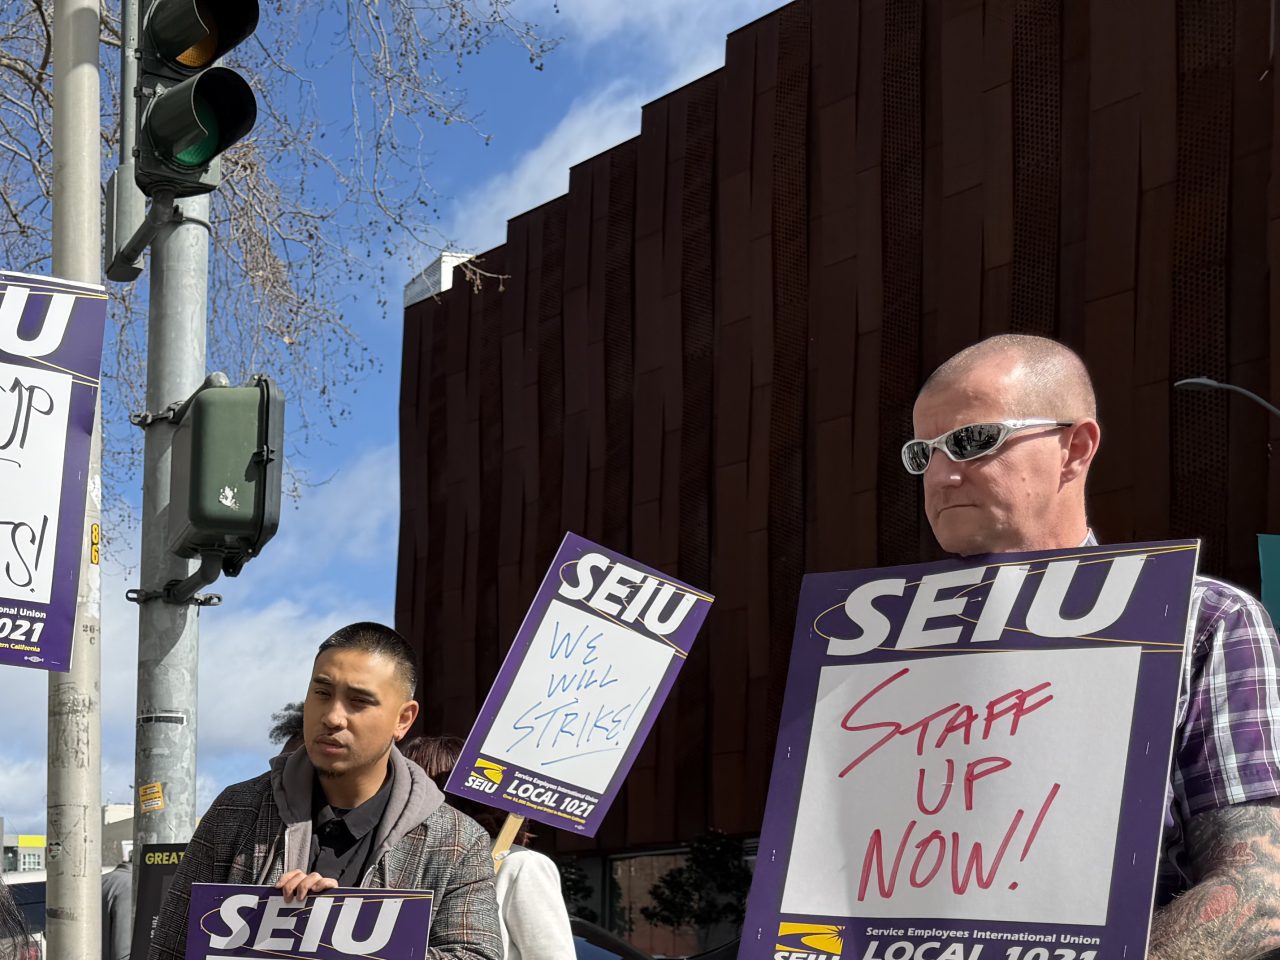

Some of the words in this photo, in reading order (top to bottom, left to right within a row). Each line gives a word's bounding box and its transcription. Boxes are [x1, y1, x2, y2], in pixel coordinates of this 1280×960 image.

[20, 608, 46, 619] Union
[558, 552, 699, 636] SEIU
[826, 554, 1148, 656] SEIU
[10, 643, 41, 652] California
[549, 621, 604, 665] WE
[547, 664, 618, 698] WILL
[506, 686, 651, 752] STRIKE!
[838, 668, 1053, 778] STAFF
[465, 776, 499, 793] SEIU
[506, 779, 559, 807] LOCAL
[560, 797, 595, 817] 1021
[917, 757, 1012, 816] UP
[858, 783, 1061, 902] NOW!
[209, 894, 404, 955] SEIU
[866, 927, 905, 936] Service
[907, 928, 969, 939] Employees
[972, 930, 1056, 942] International
[1060, 935, 1100, 945] Union
